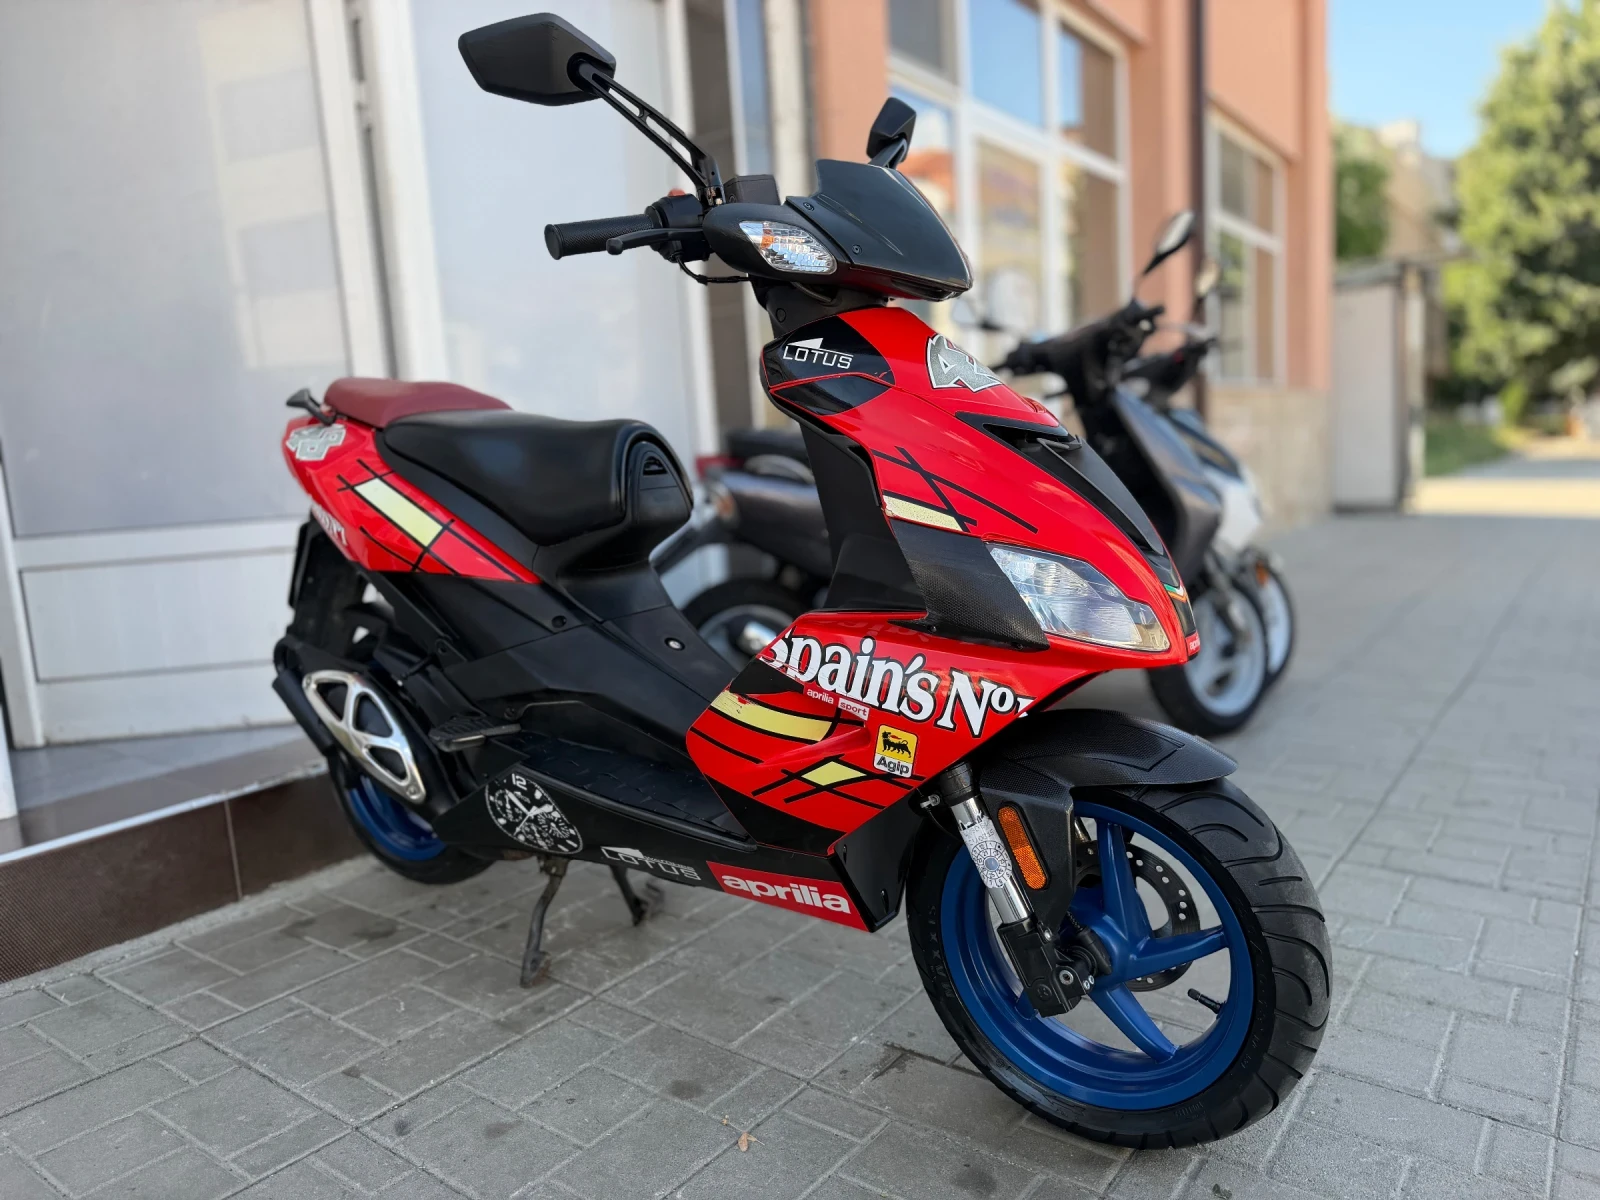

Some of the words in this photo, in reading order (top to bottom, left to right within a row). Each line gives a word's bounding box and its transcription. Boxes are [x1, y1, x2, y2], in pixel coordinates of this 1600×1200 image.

[782, 345, 854, 370] LOTUS
[806, 688, 835, 705] aprilia
[839, 701, 868, 717] sport
[875, 755, 911, 777] Agip
[511, 772, 528, 791] 12
[600, 847, 702, 881] LOTUS
[720, 873, 852, 915] aprilia
